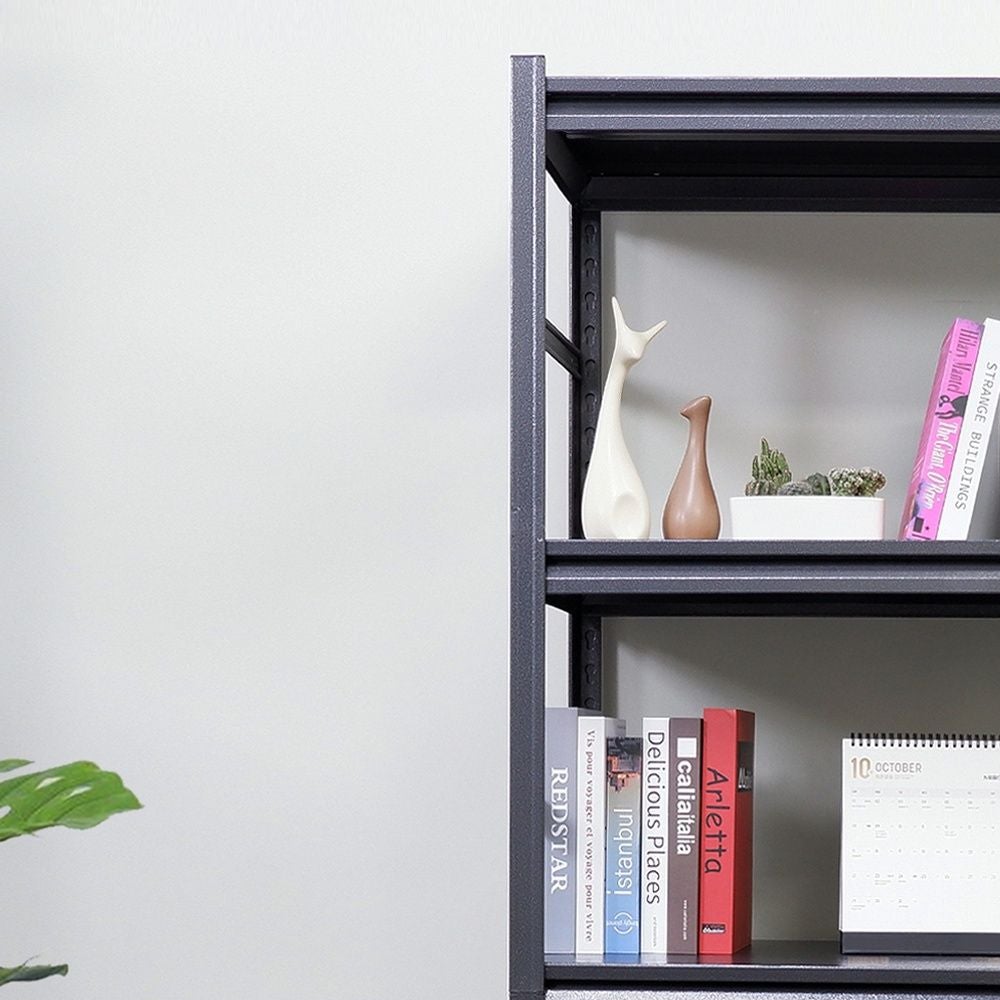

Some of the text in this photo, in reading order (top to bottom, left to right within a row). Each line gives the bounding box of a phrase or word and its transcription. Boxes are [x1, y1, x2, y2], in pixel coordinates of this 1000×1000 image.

[955, 362, 998, 510] STRANGE BUILDINGS
[587, 730, 595, 747] Vis
[586, 752, 594, 775] pour
[851, 758, 922, 779] 10 OCTOBER
[585, 780, 593, 823] voyager
[646, 732, 665, 904] Delicious Places
[677, 761, 697, 855] caliaitalia
[704, 767, 730, 873] Arletta
[551, 767, 568, 894] REDSTAR
[585, 842, 593, 880] voyage
[585, 884, 593, 908] pour
[585, 913, 594, 942] vivre
